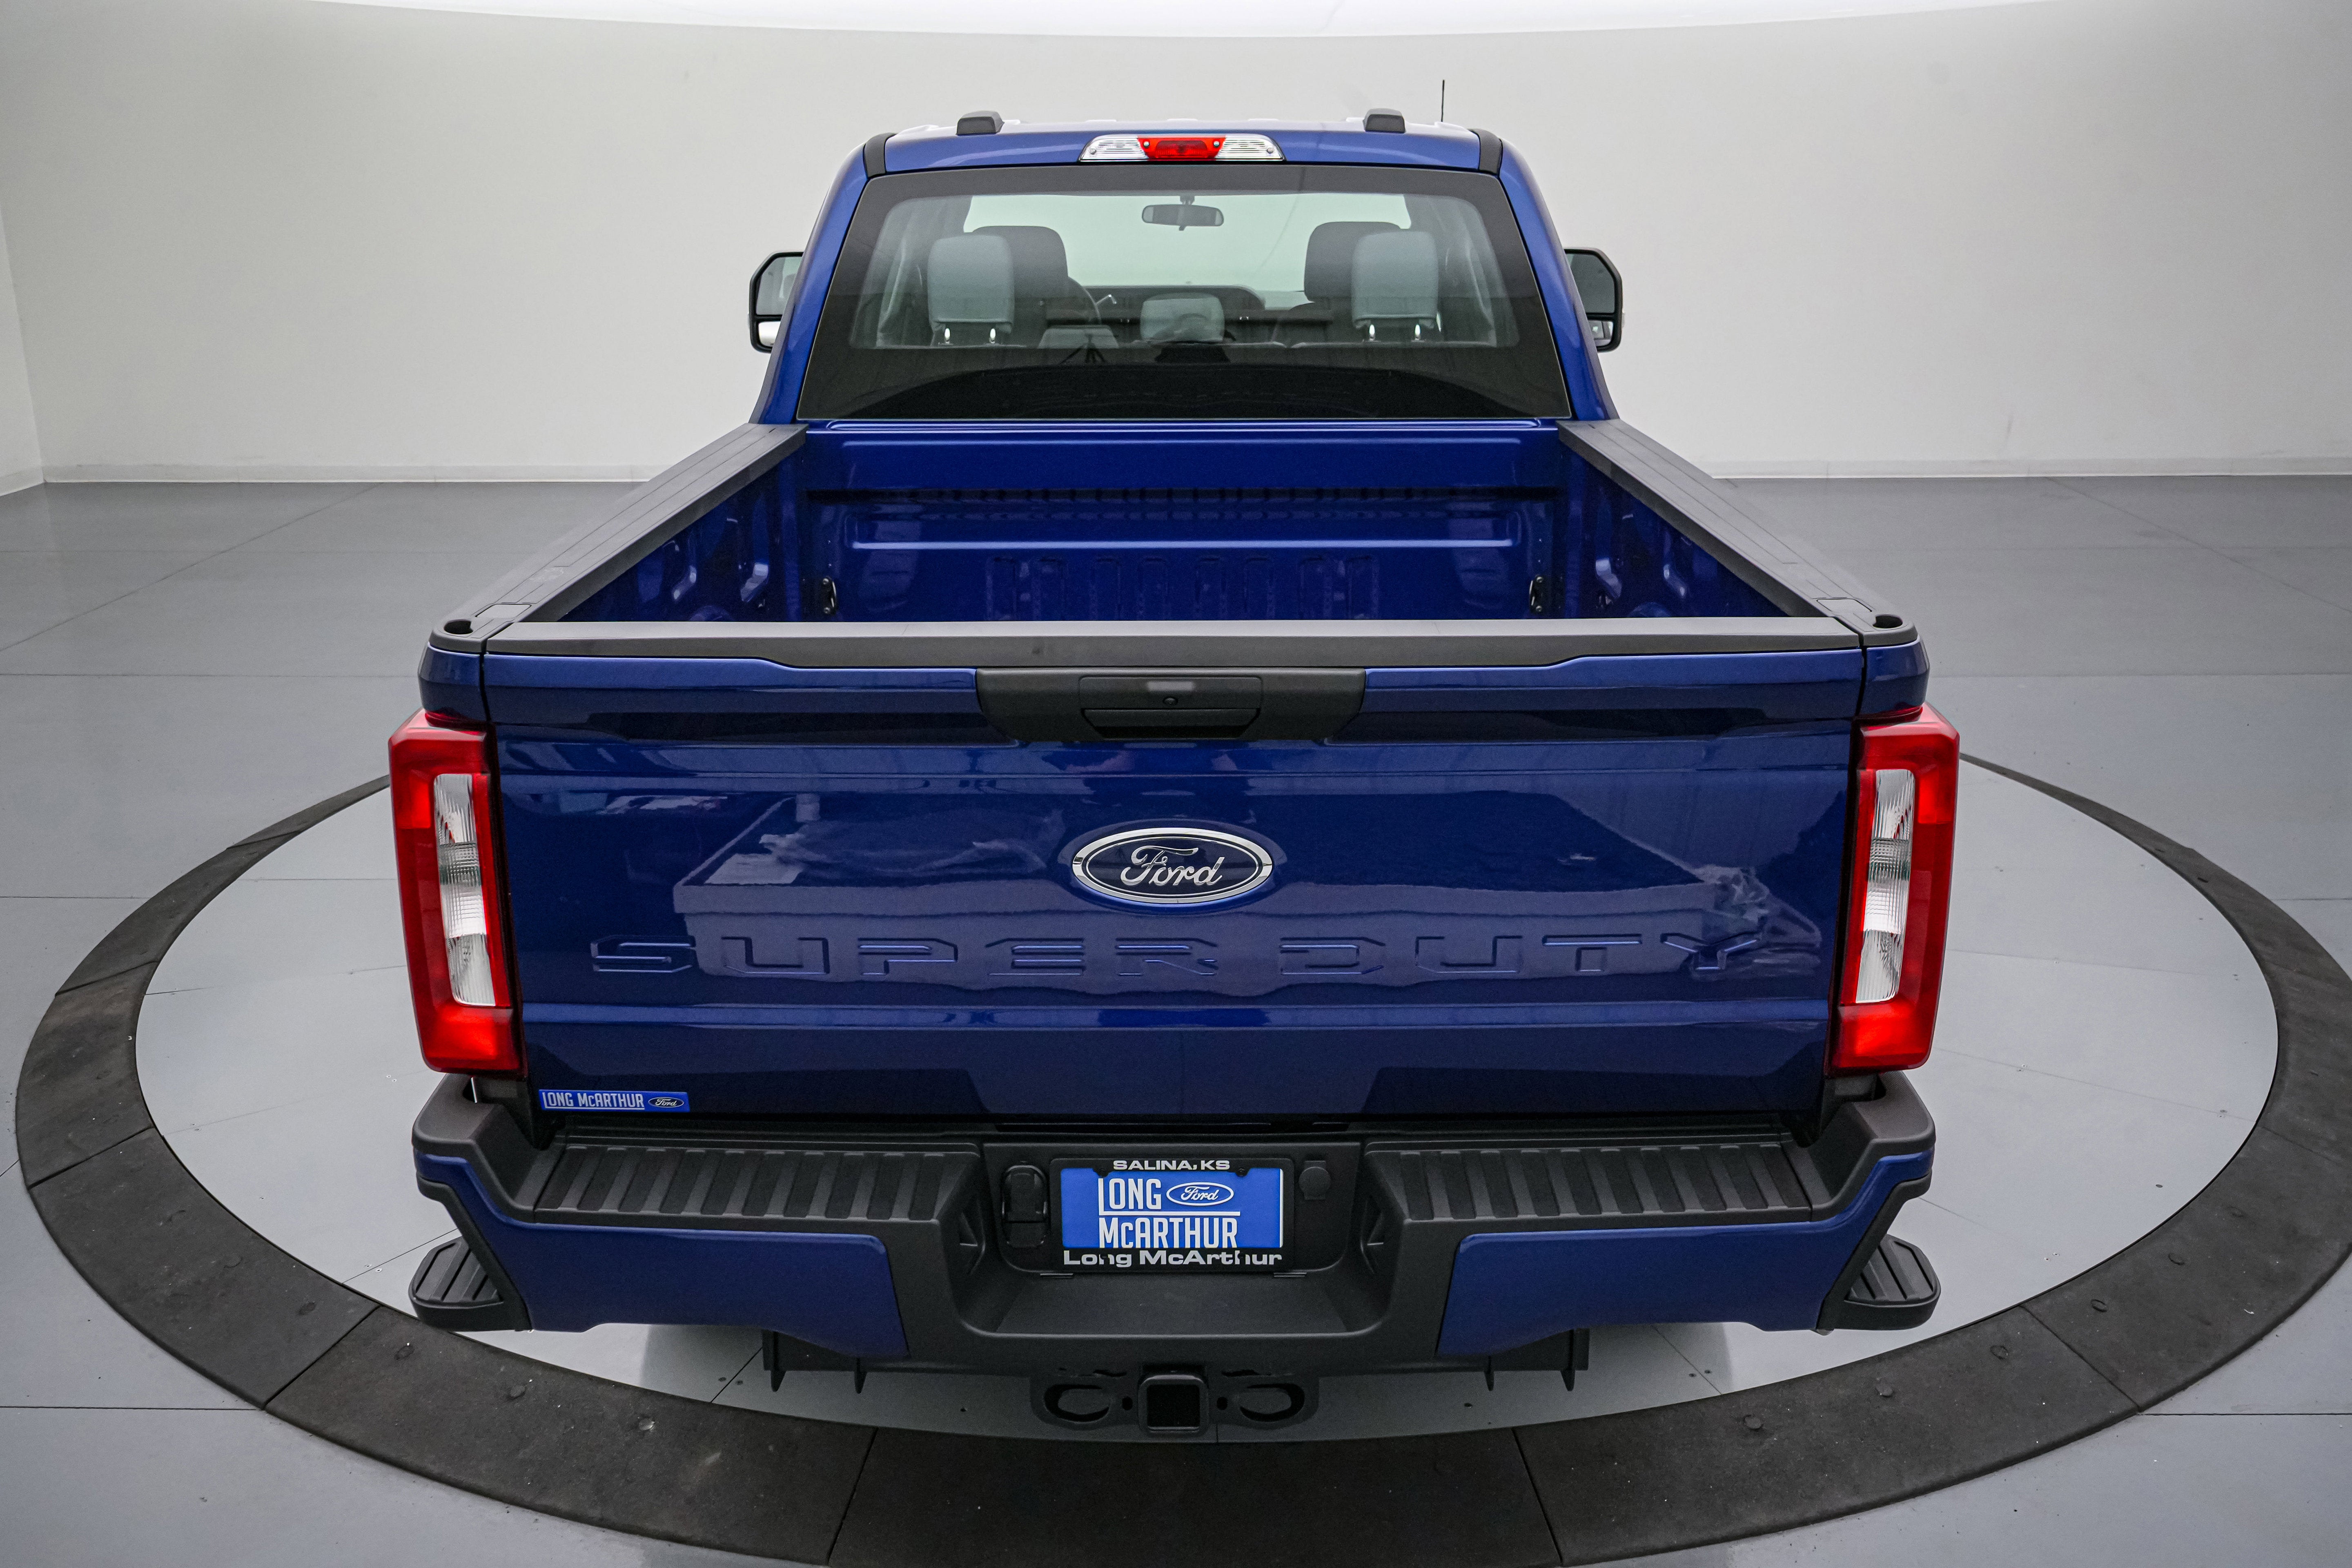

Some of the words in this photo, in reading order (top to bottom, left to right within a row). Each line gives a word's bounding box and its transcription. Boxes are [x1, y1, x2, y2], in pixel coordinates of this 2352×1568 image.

[1120, 845, 1225, 886] Ford
[590, 934, 1218, 976] SUPER
[1279, 931, 1761, 975] DUTY
[542, 1092, 573, 1108] LONG
[577, 1092, 645, 1108] McARTHUR
[655, 1098, 677, 1107] Ford
[1200, 1160, 1230, 1170] KS
[1098, 1178, 1162, 1214] LONG
[1180, 1186, 1219, 1201] Ford
[1098, 1217, 1237, 1248] McARTHUR
[1064, 1250, 1132, 1267] Long
[1140, 1250, 1282, 1265] McArthur
